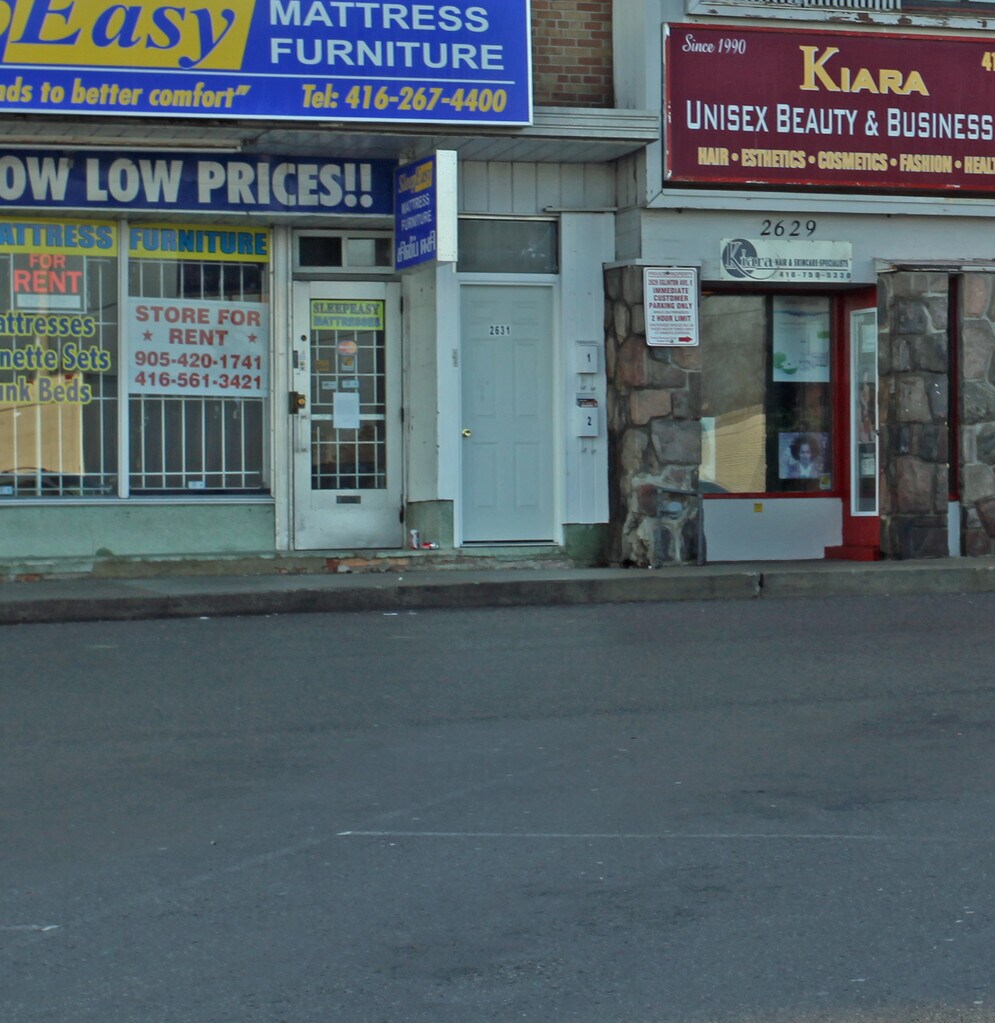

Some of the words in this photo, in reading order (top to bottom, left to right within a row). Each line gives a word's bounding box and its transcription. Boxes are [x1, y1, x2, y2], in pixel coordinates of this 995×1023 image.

[269, 0, 489, 33] MATTRESS
[270, 37, 504, 70] FURNITURE
[682, 34, 715, 54] Since
[718, 38, 746, 54] 1990
[799, 45, 930, 97] KIARA
[40, 82, 65, 103] to
[70, 78, 143, 106] better
[302, 83, 339, 109] Tel:
[345, 85, 507, 113] 416-267-4400
[686, 100, 769, 133] UNISEX
[776, 103, 858, 135] BEAUTY
[865, 110, 880, 136] &
[887, 107, 994, 141] BUSINESS
[698, 147, 729, 166] HAIR
[741, 148, 806, 169] ESTHETICS
[818, 151, 888, 171] COSMETICS
[899, 153, 953, 174] FASHION
[86, 158, 184, 203] LOW
[197, 160, 373, 208] PRICES!!
[760, 219, 816, 236] 2629
[130, 228, 267, 255] FURNITURE
[29, 254, 66, 269] FOR
[725, 242, 772, 270] Kiara
[14, 269, 82, 294] RENT
[135, 305, 210, 324] STORE
[218, 309, 260, 326] FOR
[169, 328, 228, 345] RENT
[489, 326, 510, 335] 2631
[63, 343, 110, 370] Sets
[134, 351, 261, 370] 905-420-1741
[39, 377, 92, 404] Beds
[134, 371, 261, 390] 416-561-3421
[587, 416, 592, 426] 2
